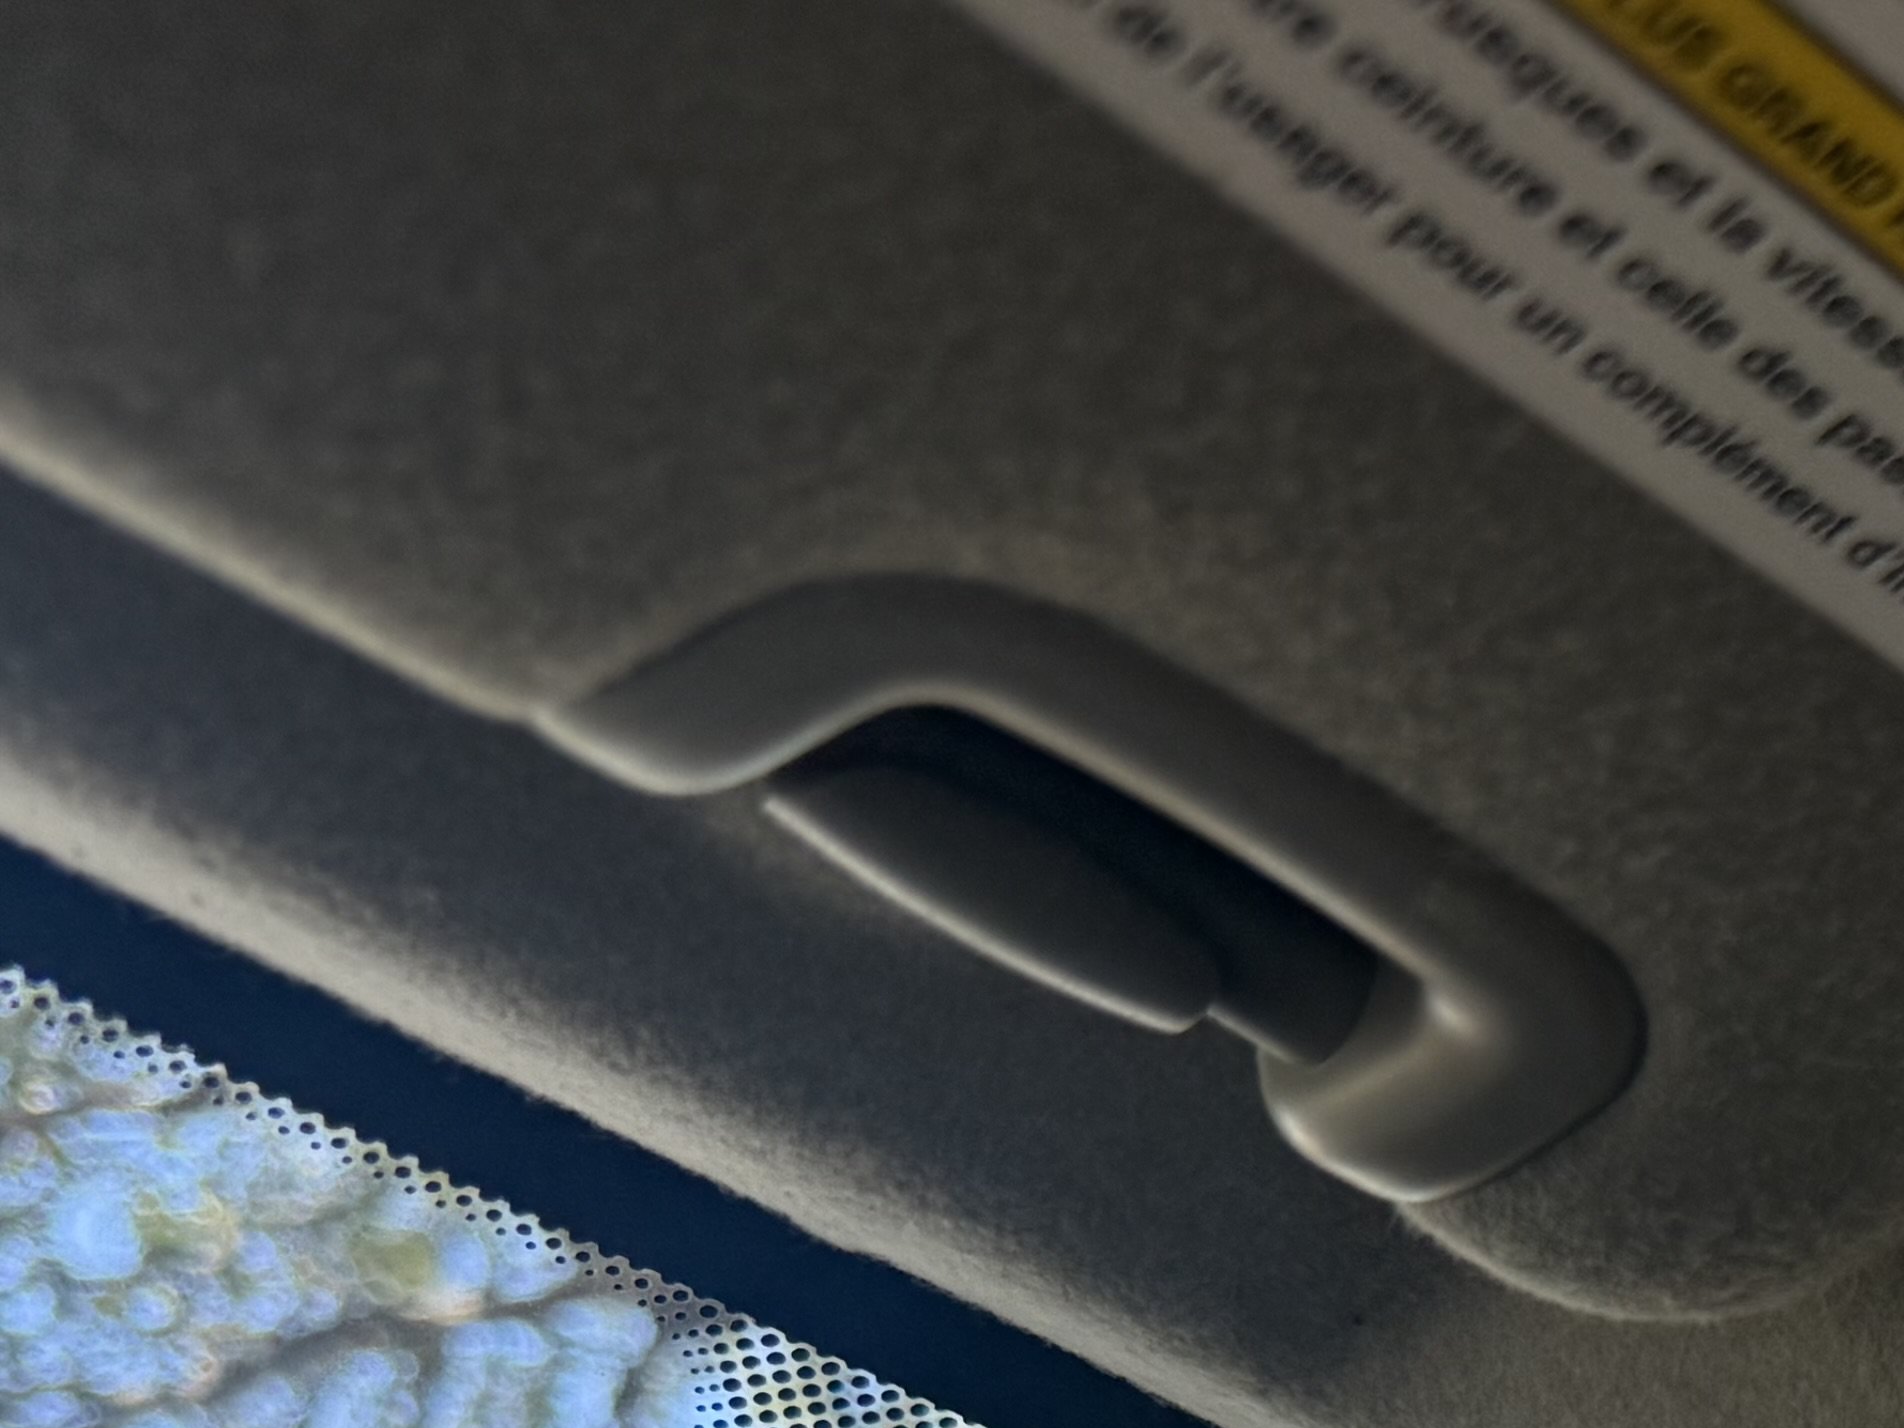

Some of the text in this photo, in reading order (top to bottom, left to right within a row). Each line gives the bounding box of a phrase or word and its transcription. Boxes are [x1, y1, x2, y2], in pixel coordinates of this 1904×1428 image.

[1337, 42, 1558, 215] ceinture
[1555, 210, 1627, 261] et
[1615, 256, 1740, 351] celle
[1736, 346, 1829, 420] des
[1408, 0, 1648, 160] usques
[1647, 158, 1714, 206] et
[1707, 198, 1768, 253] la
[1714, 60, 1897, 207] GRAND
[1385, 210, 1518, 299] pour
[1515, 298, 1587, 355] un
[1580, 348, 1857, 543] complément
